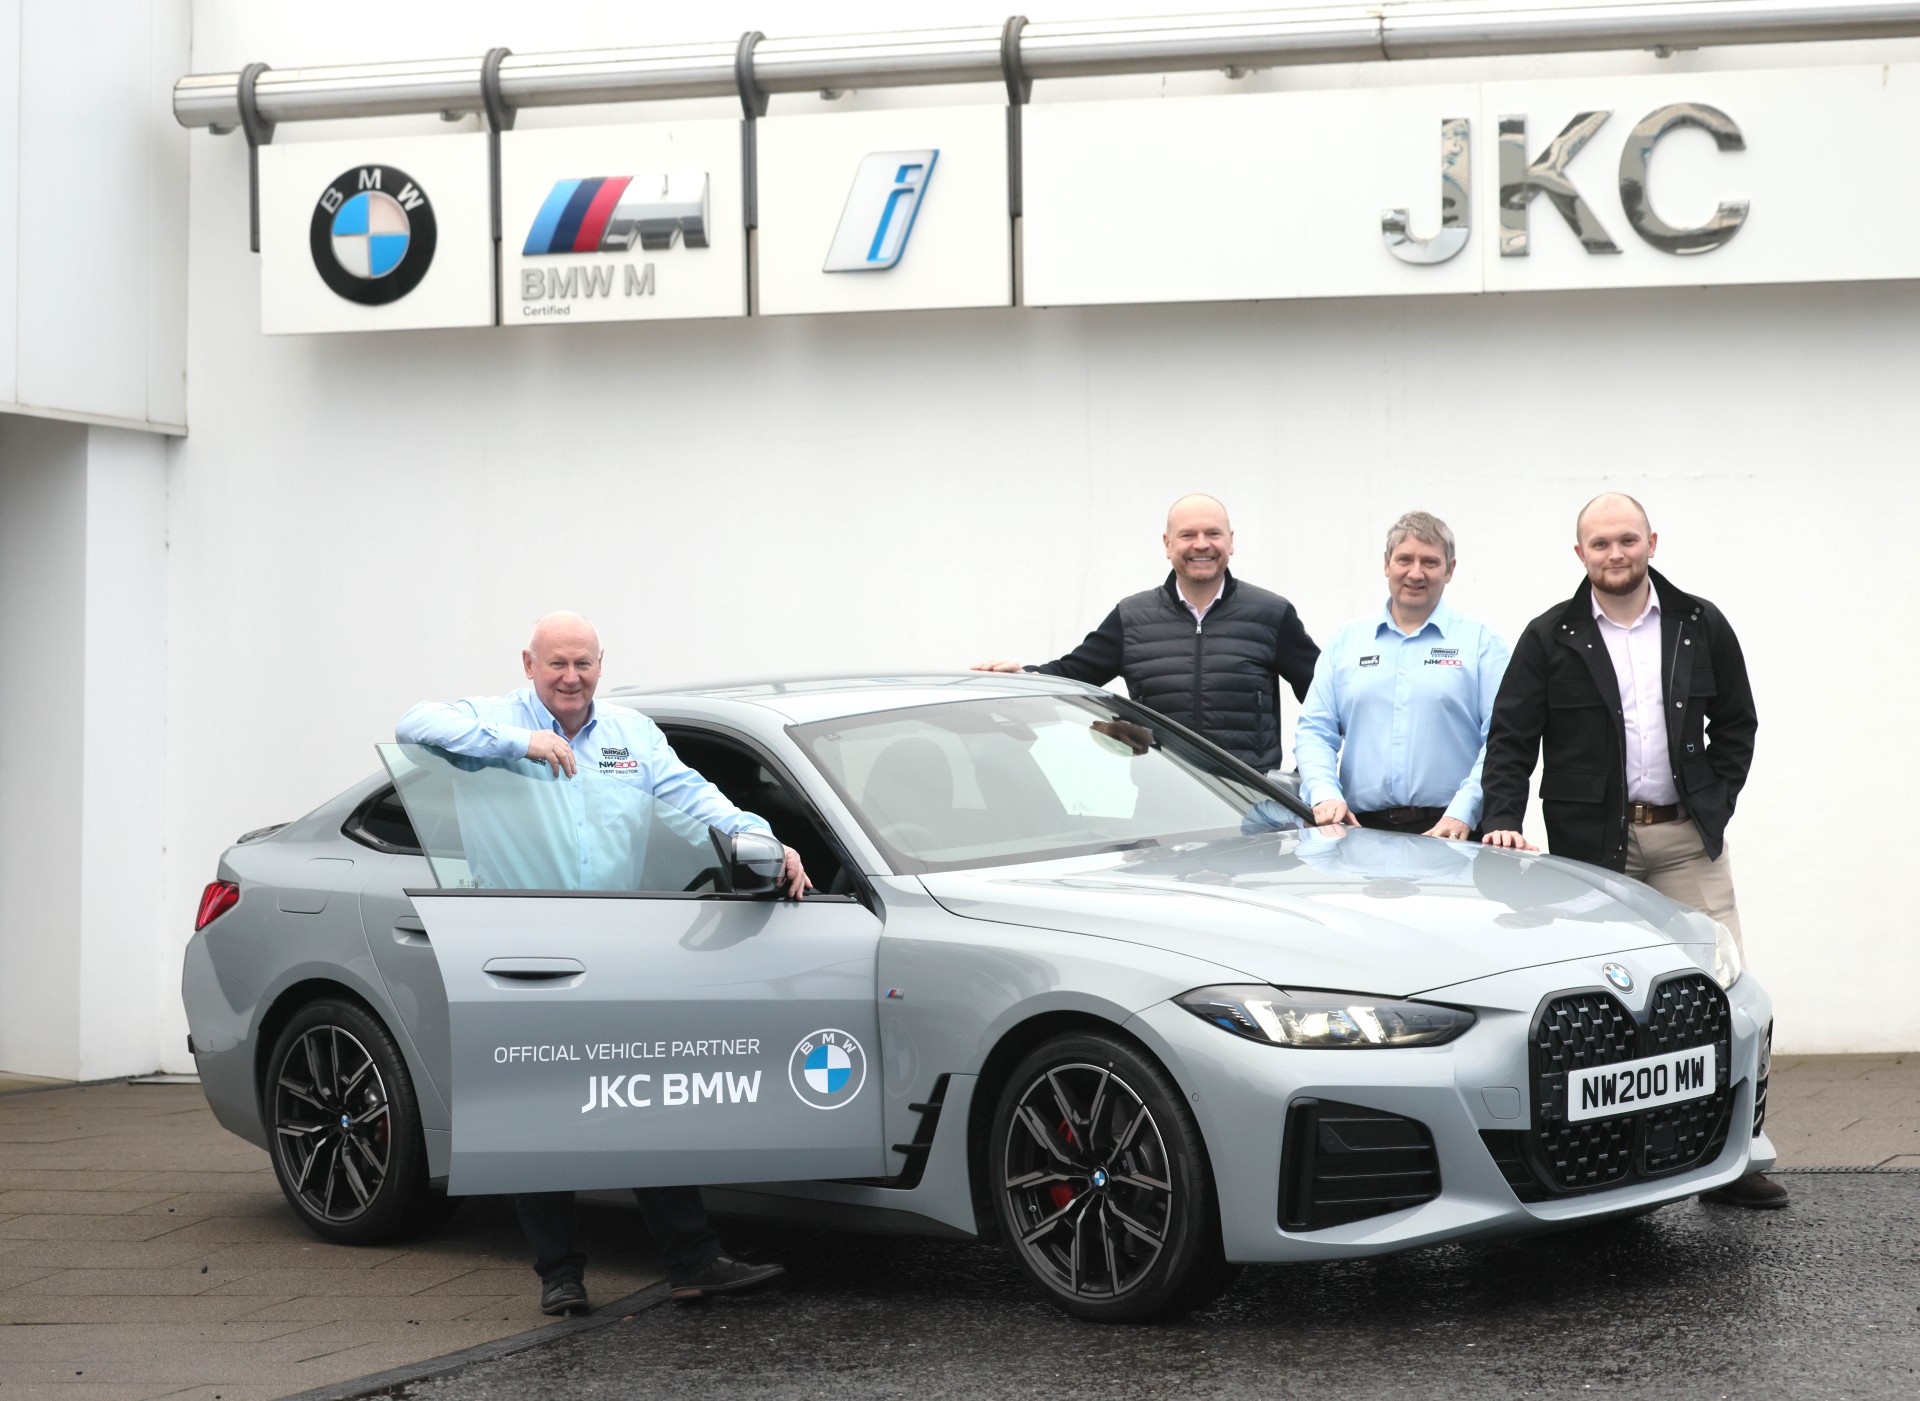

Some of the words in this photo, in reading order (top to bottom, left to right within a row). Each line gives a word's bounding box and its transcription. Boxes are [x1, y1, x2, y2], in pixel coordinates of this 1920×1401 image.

[320, 168, 425, 214] BMW
[1381, 102, 1750, 264] JKC
[521, 265, 615, 301] BMW
[624, 263, 655, 297] M
[523, 305, 571, 317] Certified
[599, 760, 638, 768] NW200
[494, 1044, 580, 1063] OFFICIAL
[585, 1041, 666, 1059] VEHICLE
[672, 1038, 760, 1057] PARTNER
[800, 1033, 857, 1056] BMW
[581, 1074, 652, 1114] JKC
[663, 1070, 762, 1106] BMW
[1582, 1064, 1668, 1110] NW200
[1675, 1056, 1705, 1092] MW
